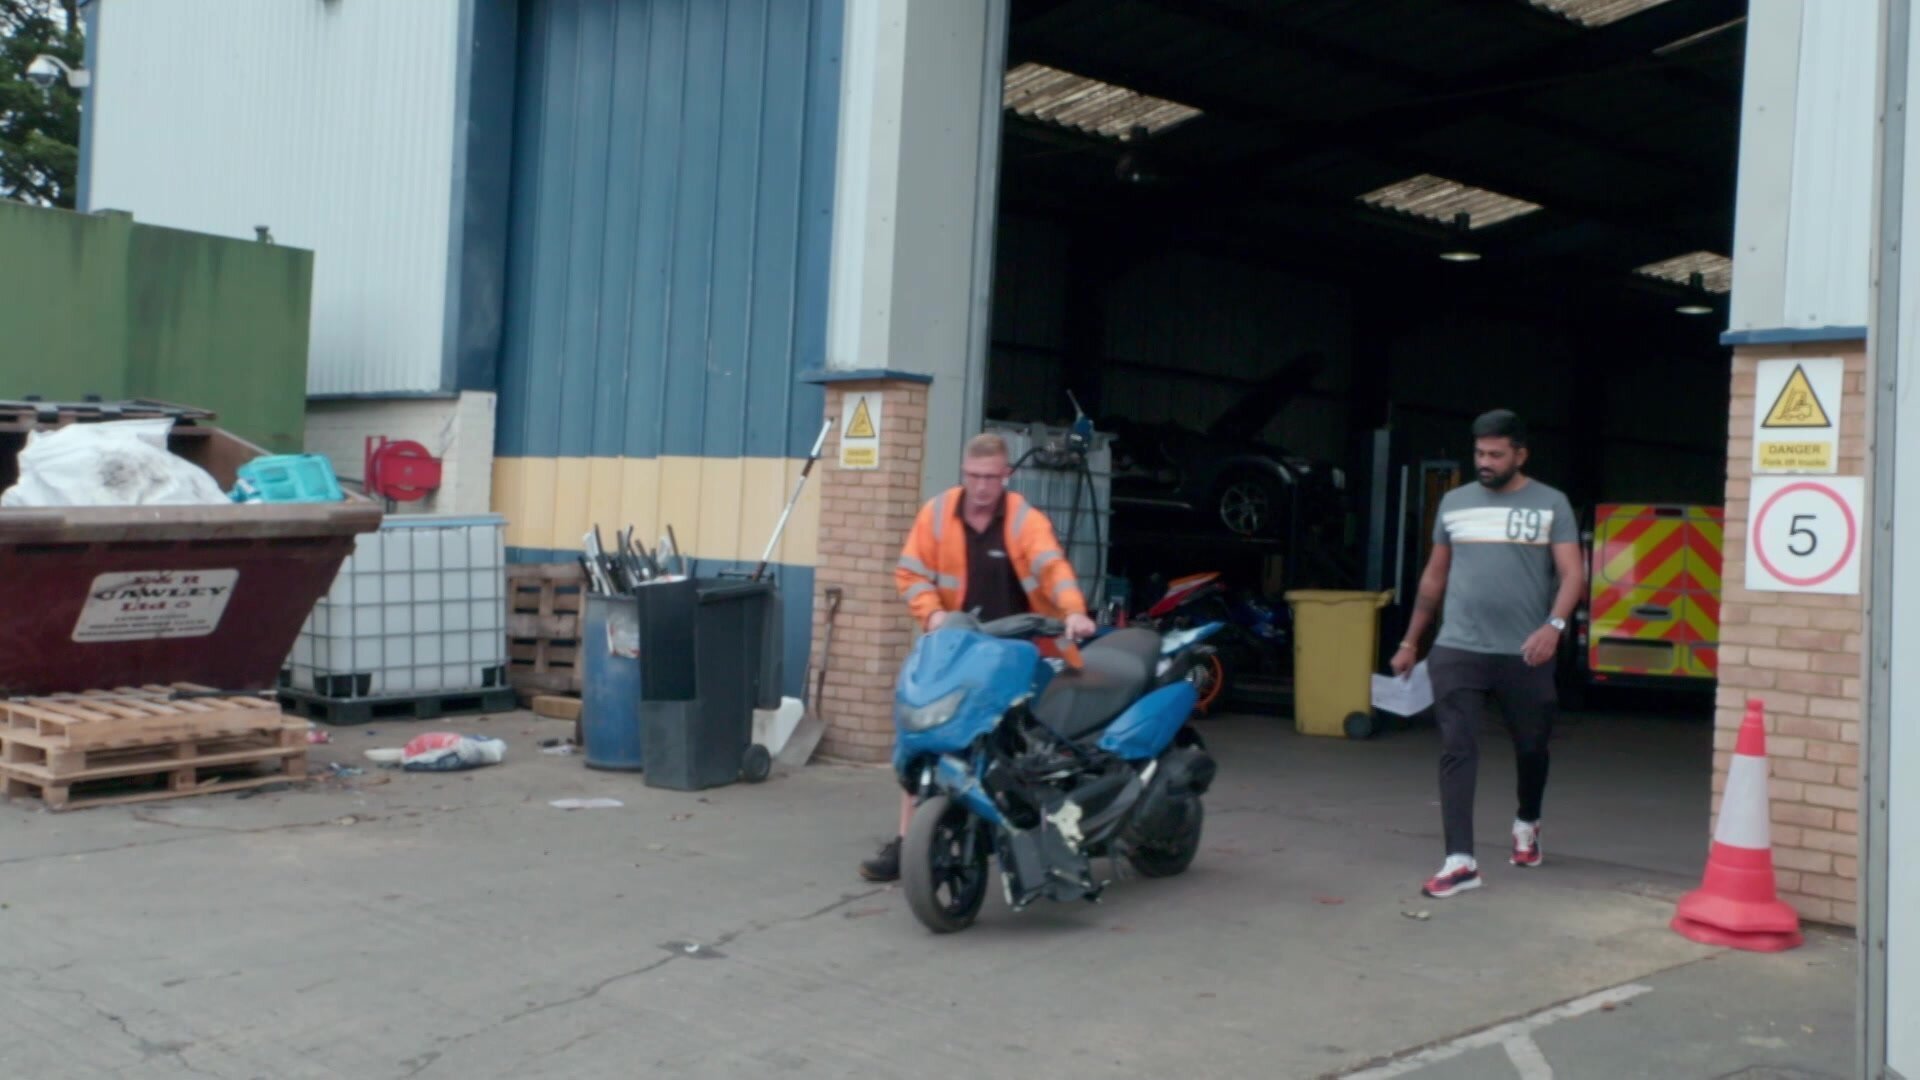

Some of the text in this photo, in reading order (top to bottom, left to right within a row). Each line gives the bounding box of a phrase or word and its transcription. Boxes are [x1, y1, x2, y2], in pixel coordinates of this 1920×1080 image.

[1768, 444, 1821, 455] DANGER
[1506, 507, 1541, 541] G9
[1787, 514, 1817, 557] 5
[93, 586, 227, 601] CAWLEY
